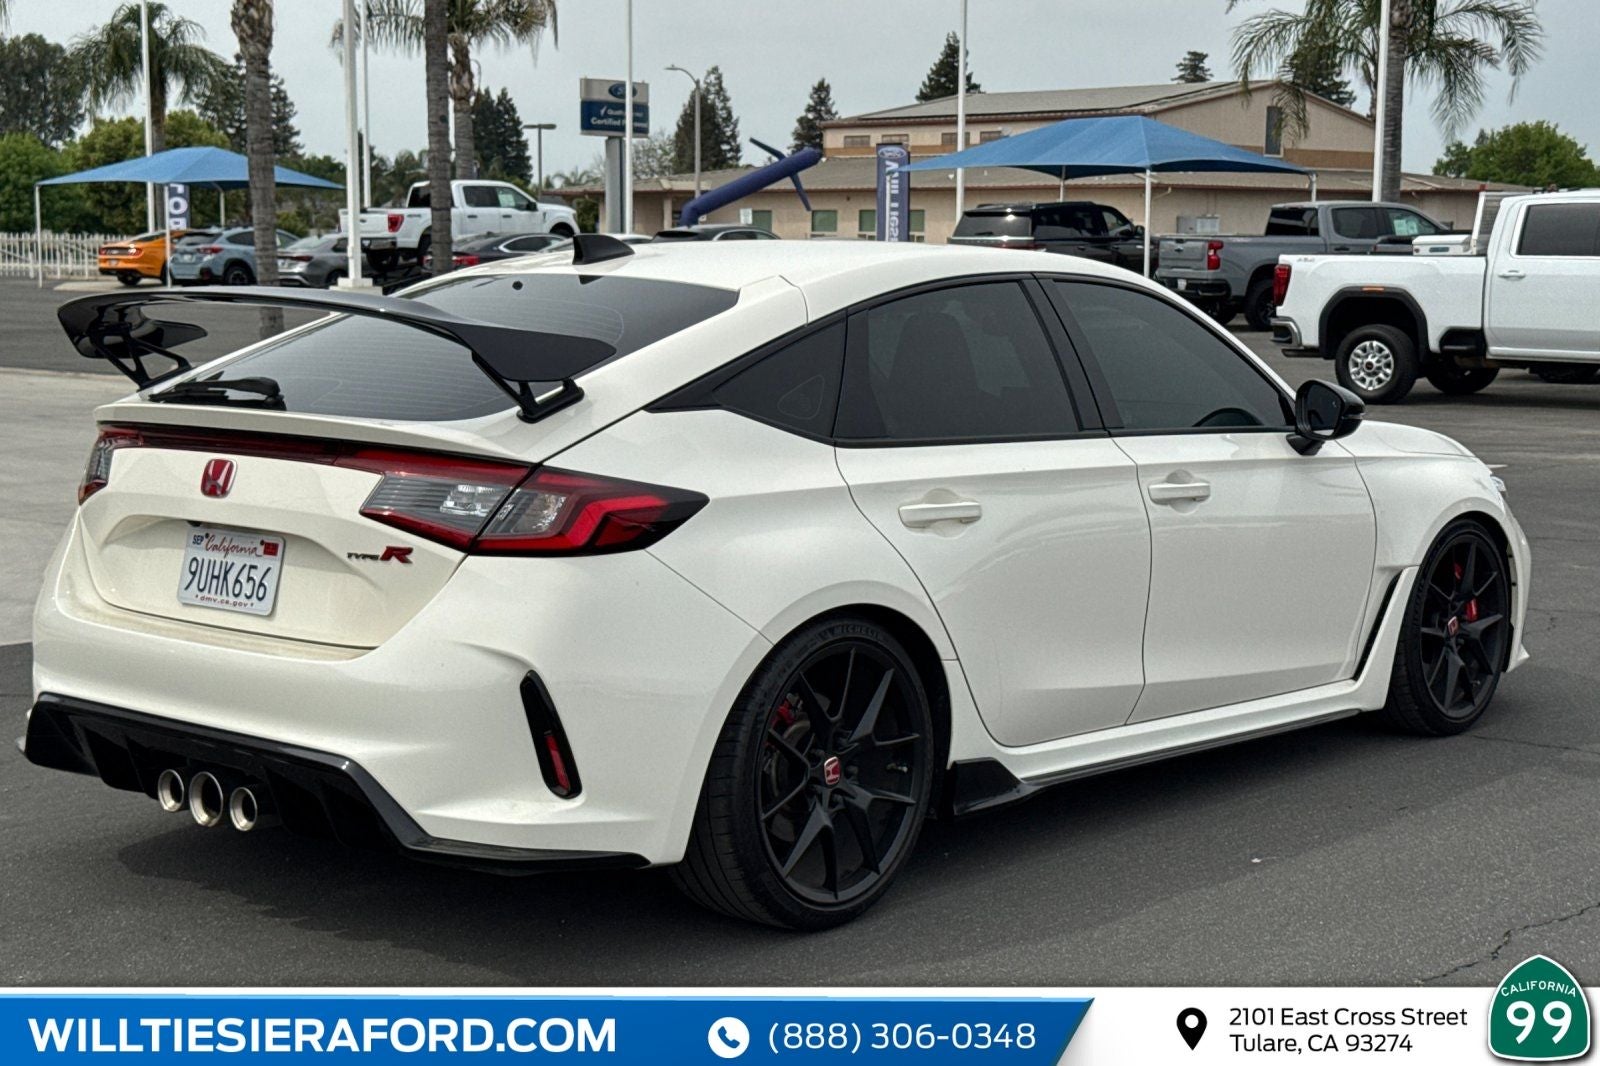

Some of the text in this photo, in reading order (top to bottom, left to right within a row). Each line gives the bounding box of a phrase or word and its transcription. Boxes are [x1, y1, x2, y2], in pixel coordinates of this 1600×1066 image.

[192, 534, 205, 546] SEP
[205, 534, 263, 559] California
[380, 545, 414, 564] R
[184, 556, 272, 602] 9UHK656
[200, 594, 249, 608] dmv.ca.gov
